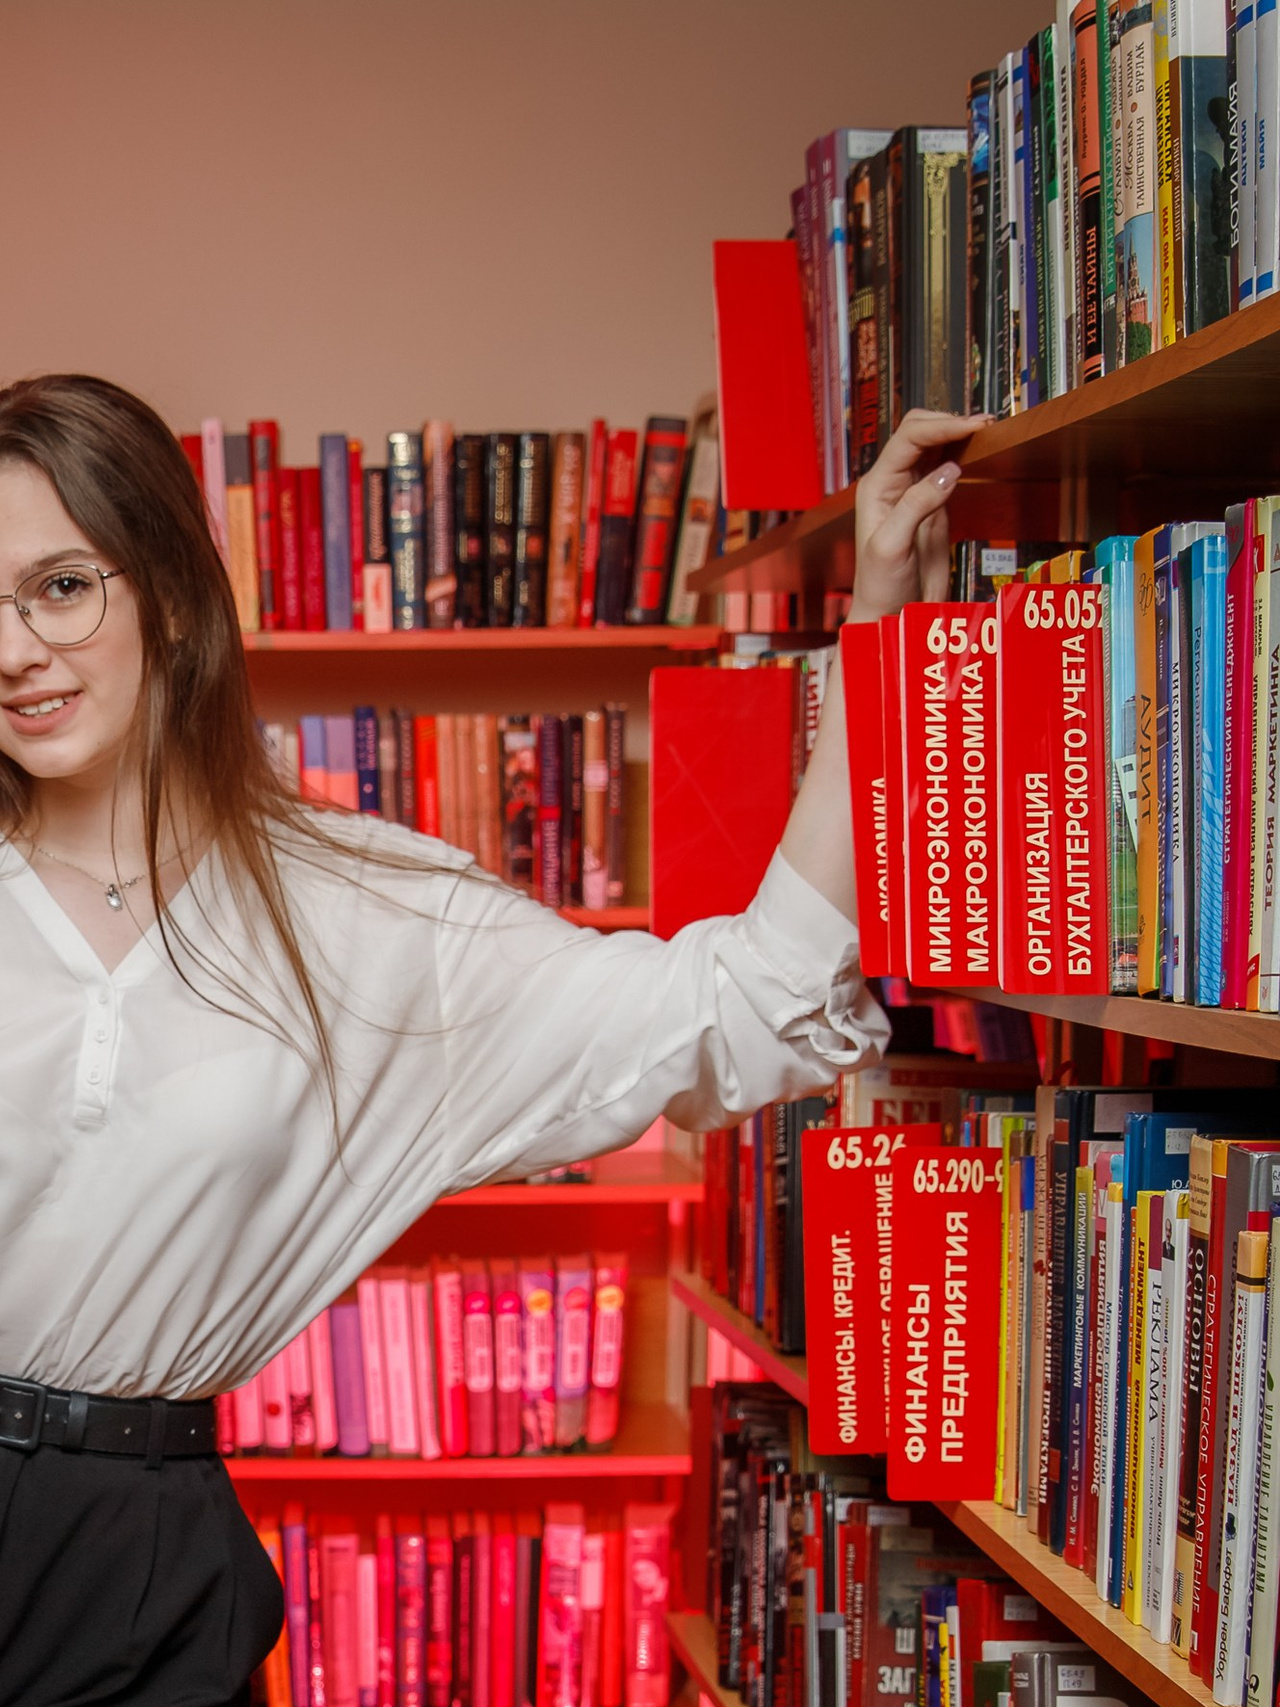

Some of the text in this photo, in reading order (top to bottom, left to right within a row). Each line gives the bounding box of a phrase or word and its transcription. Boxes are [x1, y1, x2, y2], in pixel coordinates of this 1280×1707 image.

[1126, 50, 1134, 98] ВАДИМ
[1135, 41, 1145, 93] БУРЛАК
[1258, 119, 1266, 170] МАЙЯ
[1135, 116, 1146, 209] ТАИНСТВЕННАЯ
[1228, 81, 1240, 248] БОГИ МАЙЯ
[1240, 119, 1248, 187] АЦТЕКИ
[1084, 226, 1097, 345] И ЕЕ ТАЙНЫ
[926, 617, 998, 655] 65.0
[1023, 590, 1104, 629] 65.05
[1061, 633, 1092, 975] БУХГАЛТЕРСКОГО УЧЕТА
[1140, 694, 1154, 824] АУДИТ
[1171, 661, 1181, 863] МИКРОЭКОНОМИКА
[1222, 592, 1237, 864] СТРАТЕГИЧЕСКИЙ МЕНЕДЖМЕНТ
[1264, 644, 1280, 911] ТЕОРИЯ МАРКЕТИНГА
[923, 659, 952, 972] МИКРОЭКОНОМИКА
[960, 660, 990, 972] МАКРОЭКОНОМИКА
[1025, 773, 1054, 976] ОРГАНИЗАЦИЯ
[831, 1230, 858, 1444] ФИНАНСЫ. КРЕДИТ.
[940, 1211, 970, 1463] ПРЕДПРИЯТИЯ
[1073, 1192, 1087, 1388] МАРКЕТИНГОВЫЕ КОММУНИКАЦИИ
[1090, 1239, 1108, 1497] Экономика предприятия
[1147, 1281, 1162, 1422] РЕКЛАМА
[1160, 1346, 1170, 1380] 100%
[1162, 1297, 1171, 1345] ремикс
[1188, 1247, 1205, 1392] ОСНОВЫ
[904, 1284, 930, 1463] ФИНАНСЫ
[1100, 1301, 1112, 1484] Мастер словесной атаки
[1129, 1237, 1146, 1539] ИННОВАЦИОННЫЙ МЕНЕДЖМЕНТ
[1157, 1401, 1168, 1469] Маркетинг
[1192, 1274, 1216, 1613] СТРАТЕГИЧЕСКОЕ УПРАВЛЕНИЕ
[1226, 1294, 1245, 1505] НАЗАД В ШКОЛУ!
[1154, 1513, 1165, 1546] Игорь
[1156, 1475, 1165, 1509] Манн
[1214, 1546, 1234, 1682] Уоррен Баффет
